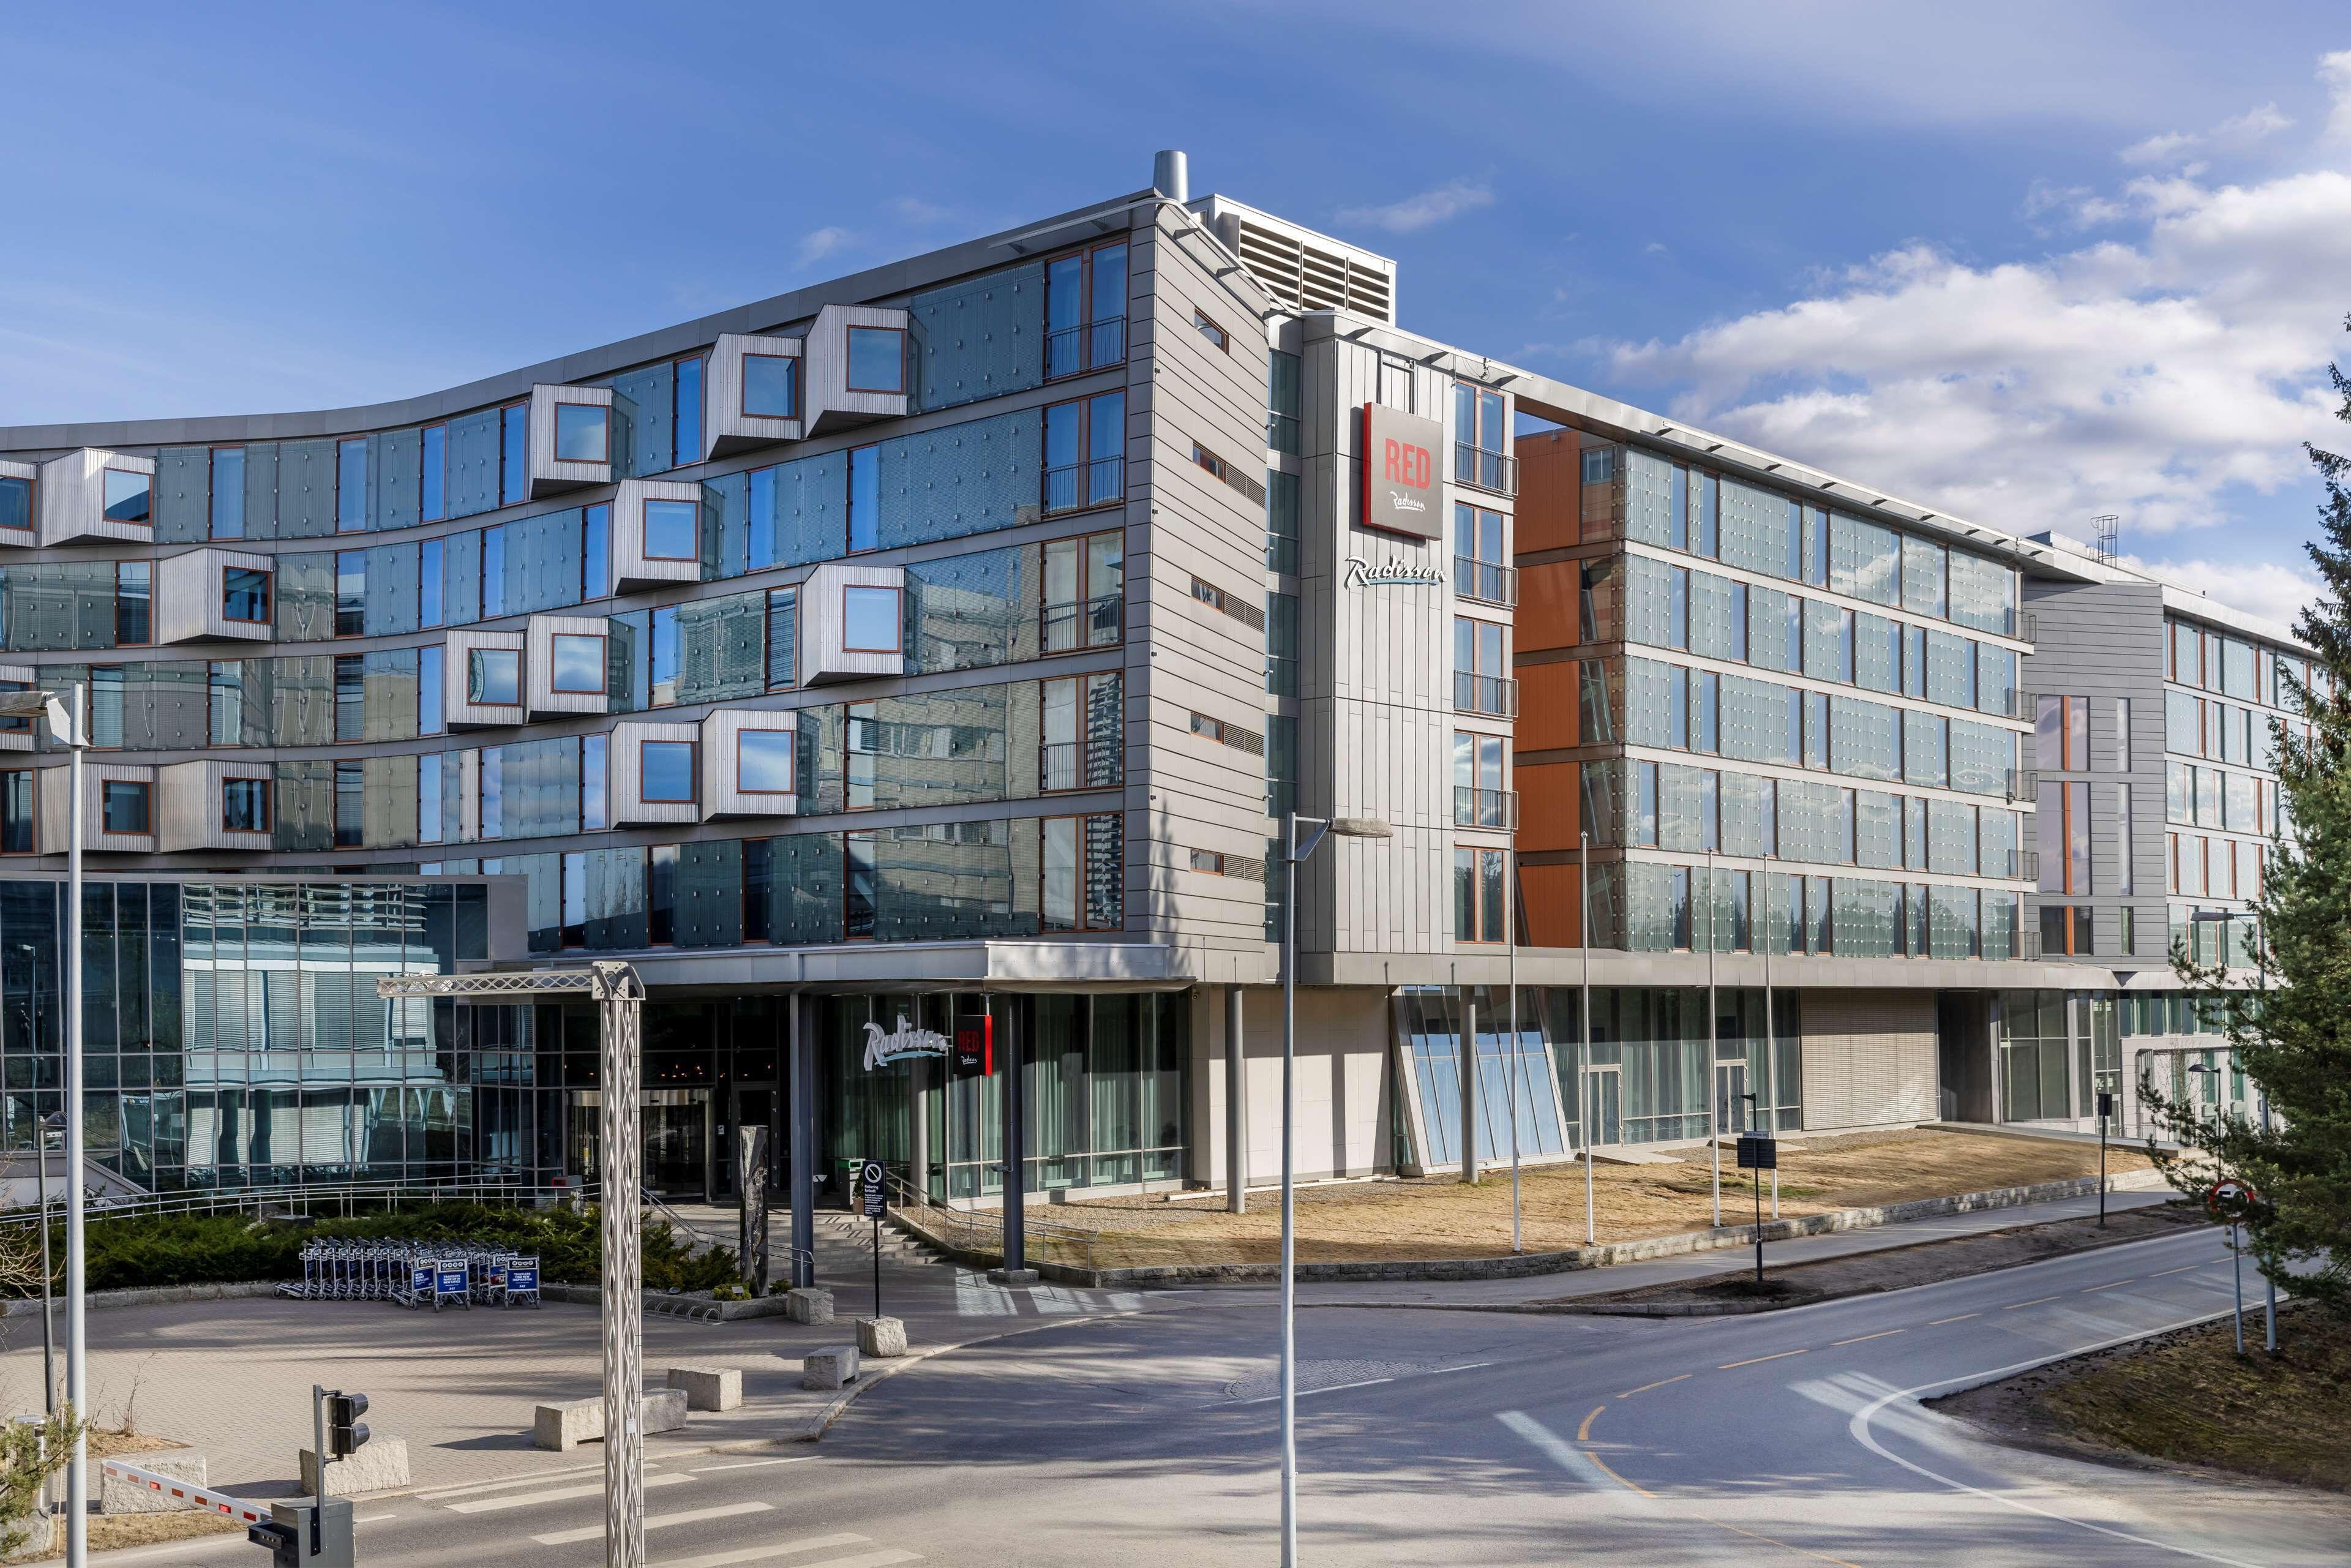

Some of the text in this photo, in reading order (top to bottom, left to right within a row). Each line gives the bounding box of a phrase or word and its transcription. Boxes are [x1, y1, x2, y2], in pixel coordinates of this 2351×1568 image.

[1385, 437, 1431, 490] RED
[1389, 490, 1426, 511] Radisson
[1345, 554, 1447, 589] Radisson
[863, 1014, 948, 1071] Radisson
[957, 1030, 980, 1052] RED
